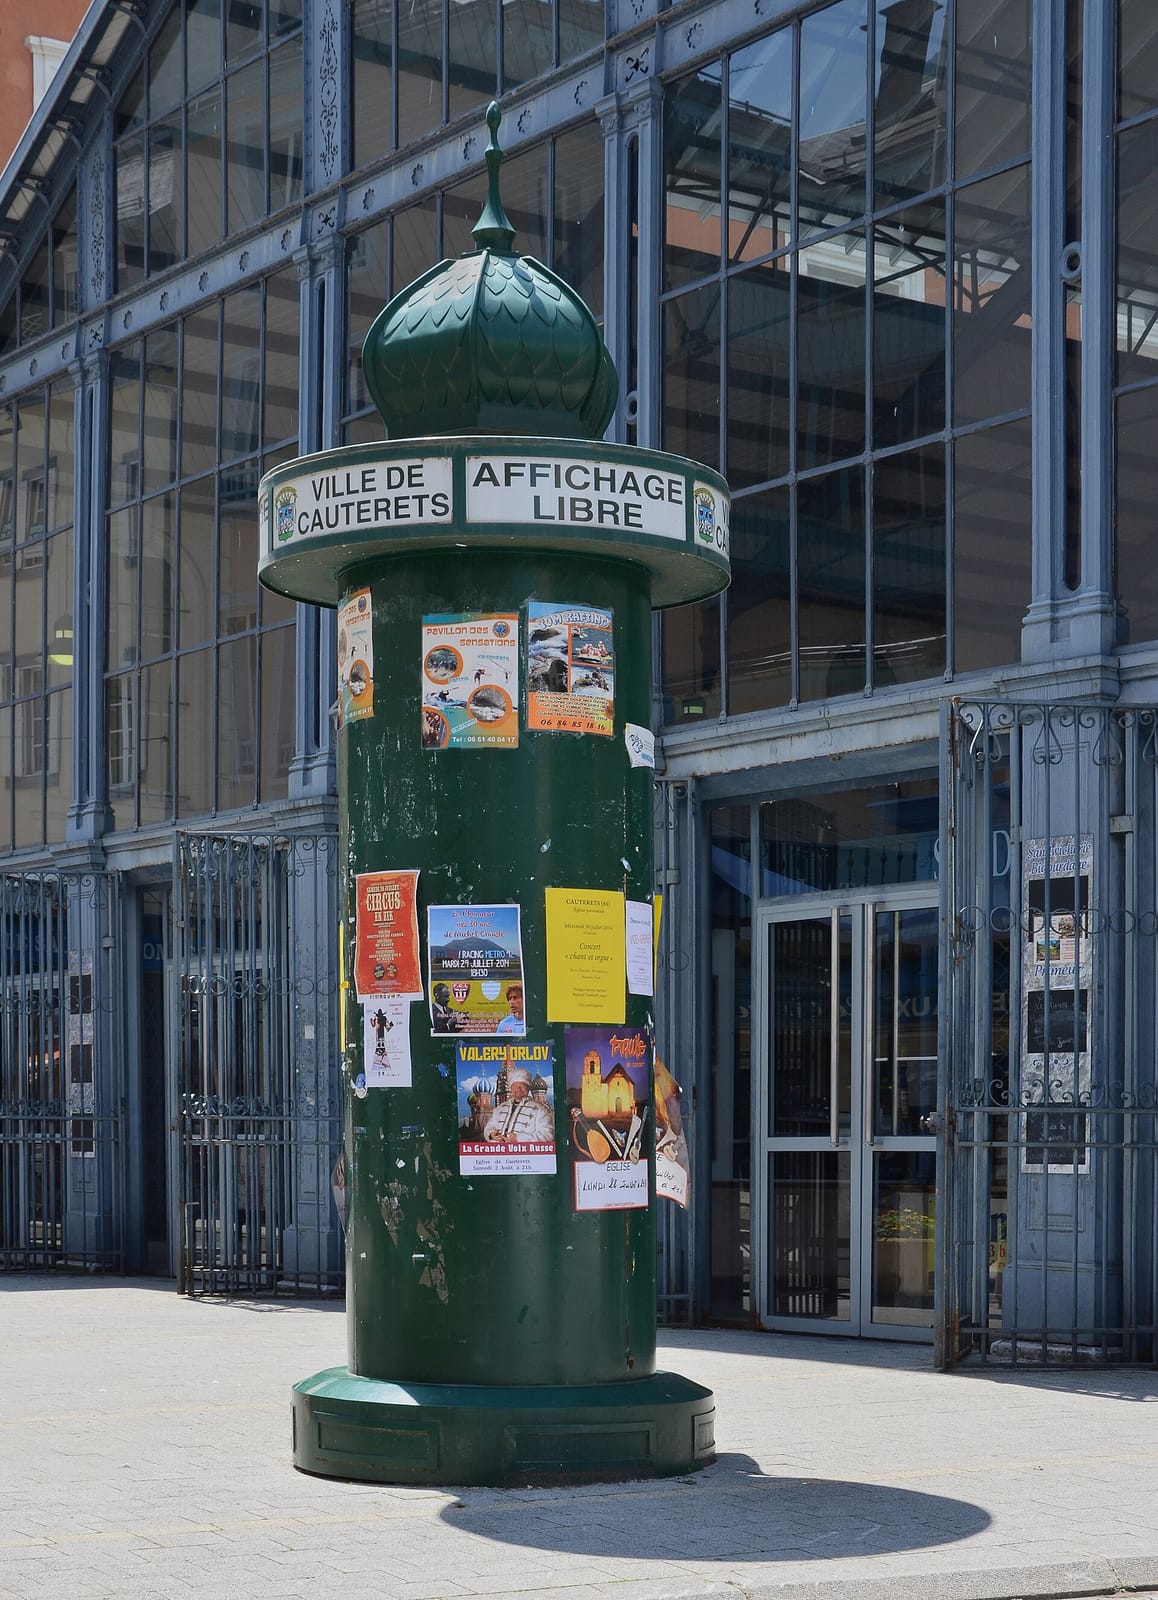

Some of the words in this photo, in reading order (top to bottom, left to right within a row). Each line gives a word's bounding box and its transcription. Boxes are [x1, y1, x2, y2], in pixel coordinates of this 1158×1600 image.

[311, 468, 377, 502] VILLE
[386, 464, 425, 490] DE
[472, 462, 683, 505] AFFICHAGE
[297, 492, 450, 535] CAUTERETS
[533, 495, 643, 528] LIBRE
[557, 719, 567, 727] 84
[571, 720, 582, 728] 85
[366, 891, 401, 912] CIRCUS
[579, 942, 600, 950] Concert
[462, 950, 484, 959] RACING
[442, 960, 460, 968] MARDI
[460, 959, 469, 968] 29
[459, 1046, 506, 1061] VALERY
[510, 1046, 549, 1060] ORLOV
[462, 1144, 472, 1152] La
[474, 1144, 505, 1153] Grande
[508, 1144, 527, 1152] Voix
[529, 1144, 553, 1152] Russe
[606, 1162, 631, 1172] EGLISE
